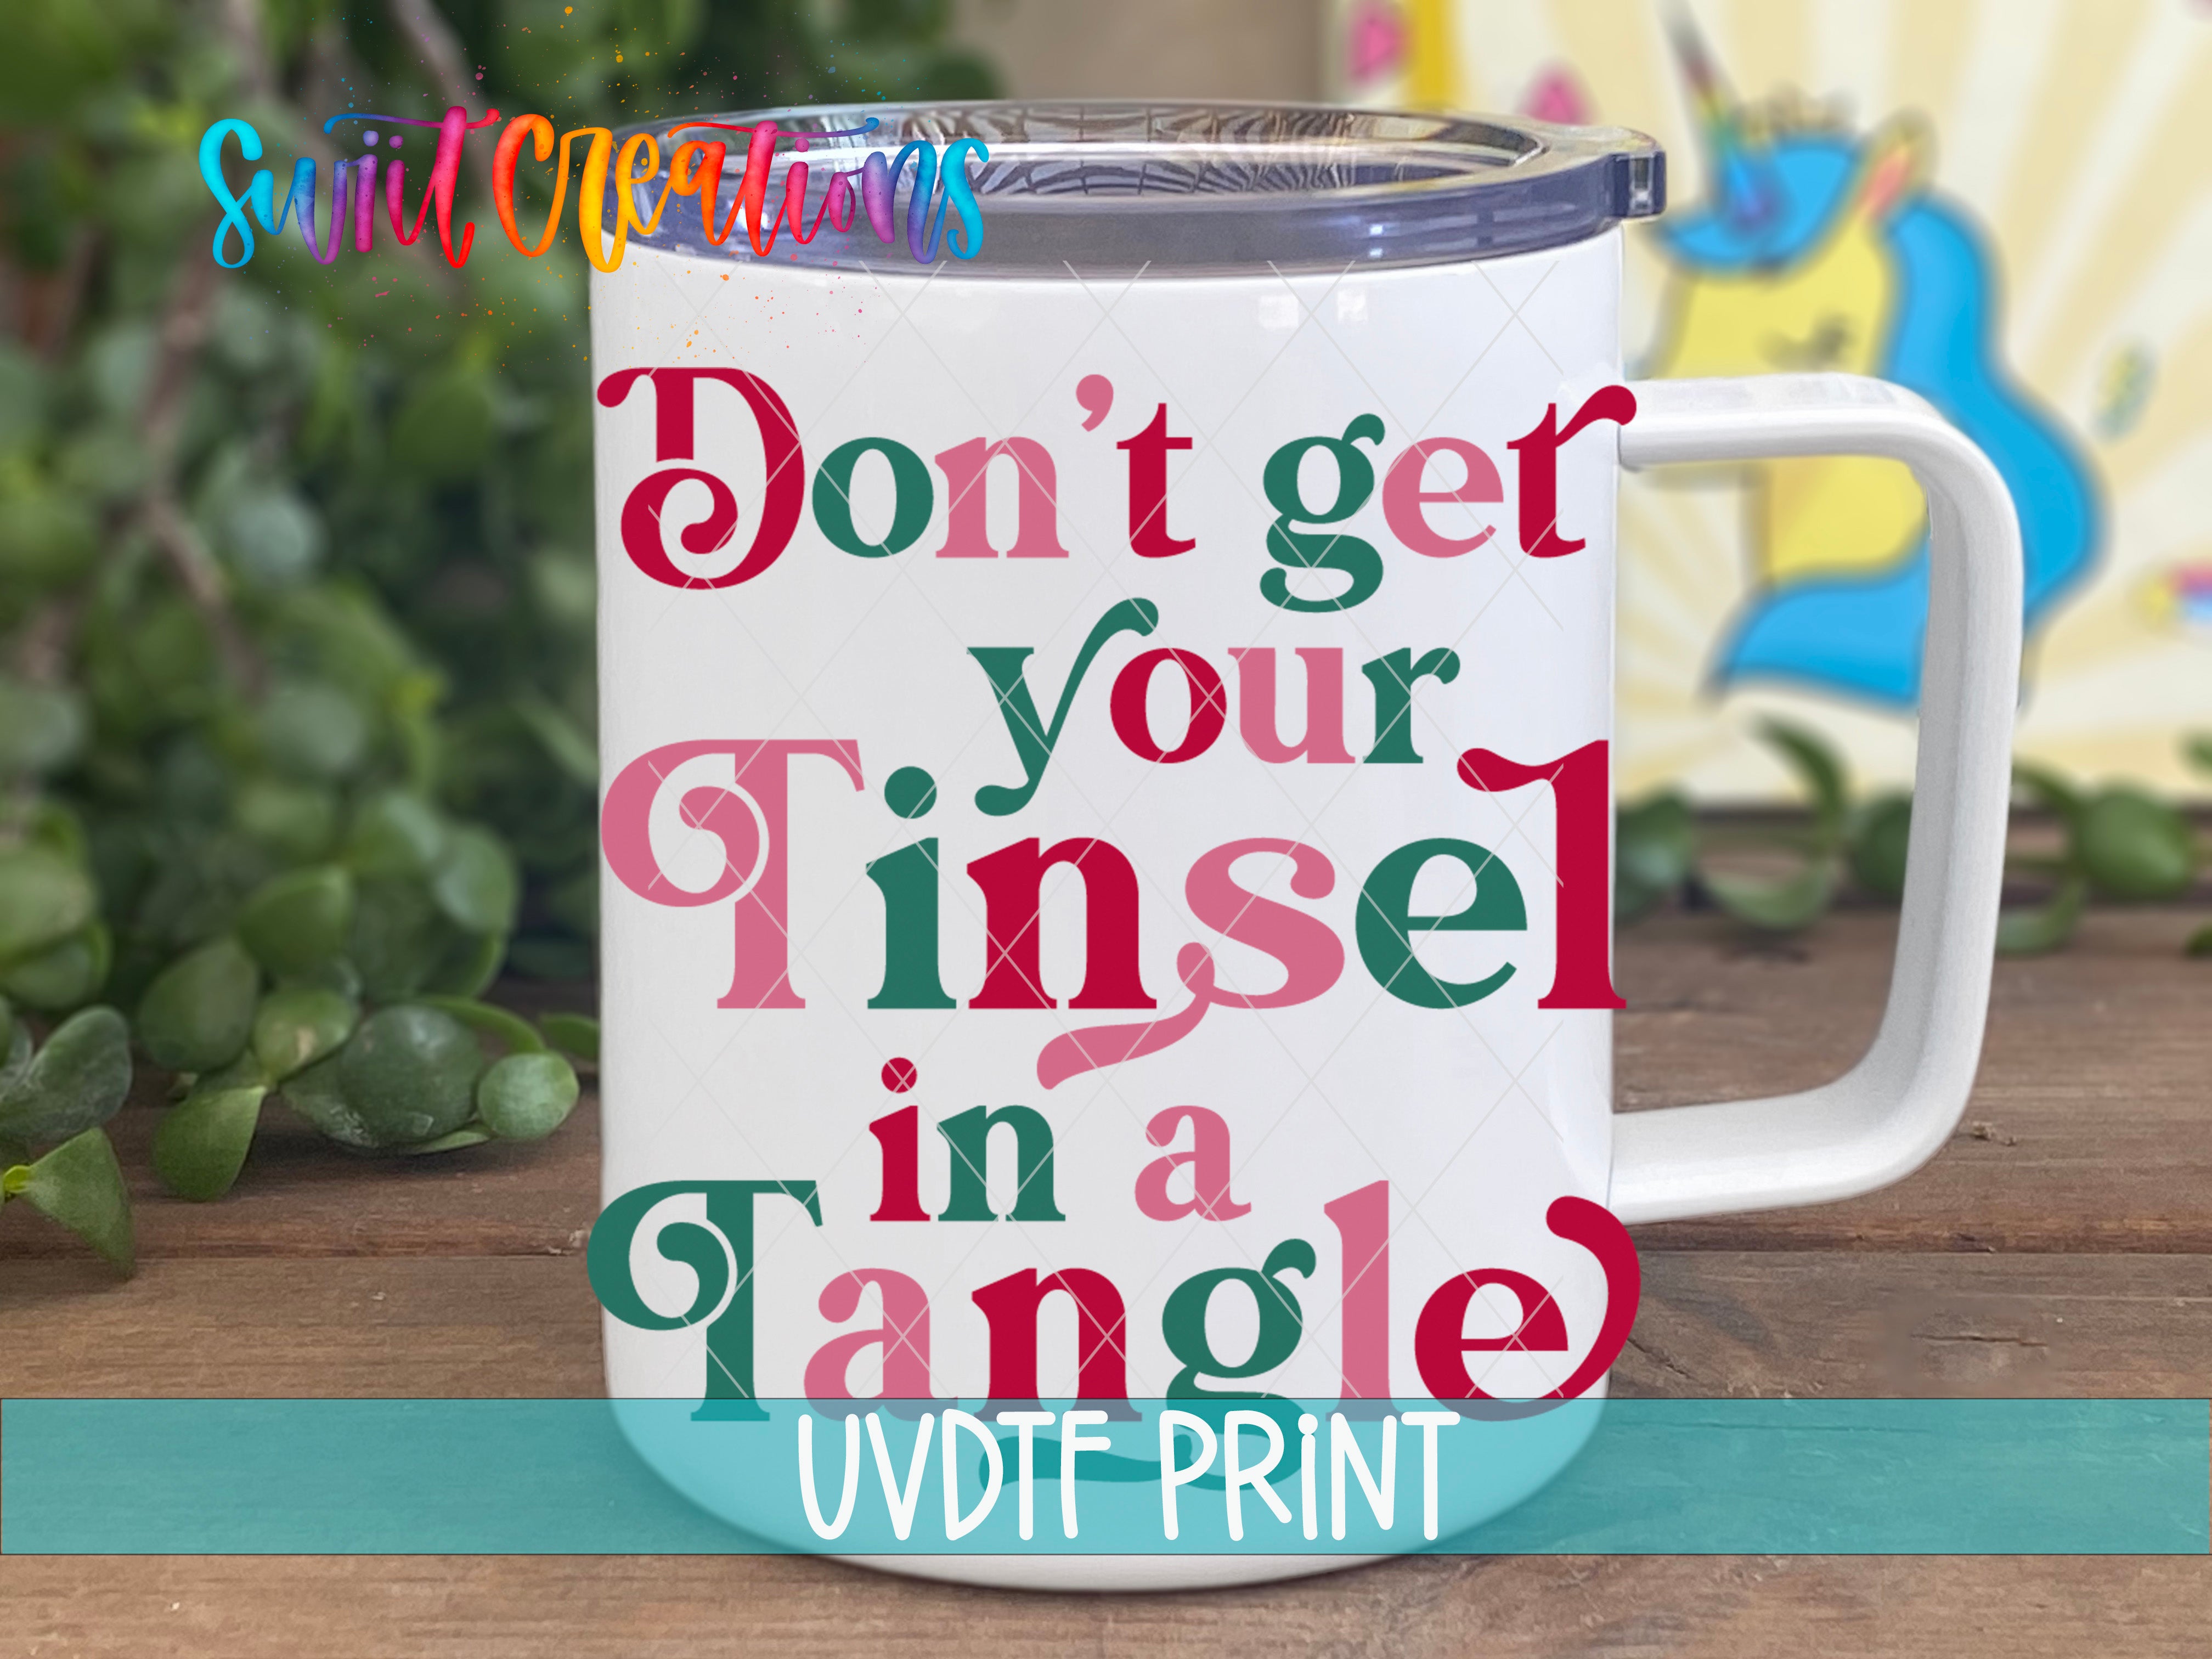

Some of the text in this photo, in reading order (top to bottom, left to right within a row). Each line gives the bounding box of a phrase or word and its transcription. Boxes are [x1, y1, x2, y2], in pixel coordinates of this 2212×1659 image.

[596, 366, 1638, 613] Don't get
[967, 596, 1461, 816] your
[600, 738, 1627, 1090] Tinsel
[870, 1057, 1252, 1222] in a
[586, 1179, 1641, 1491] Tangle
